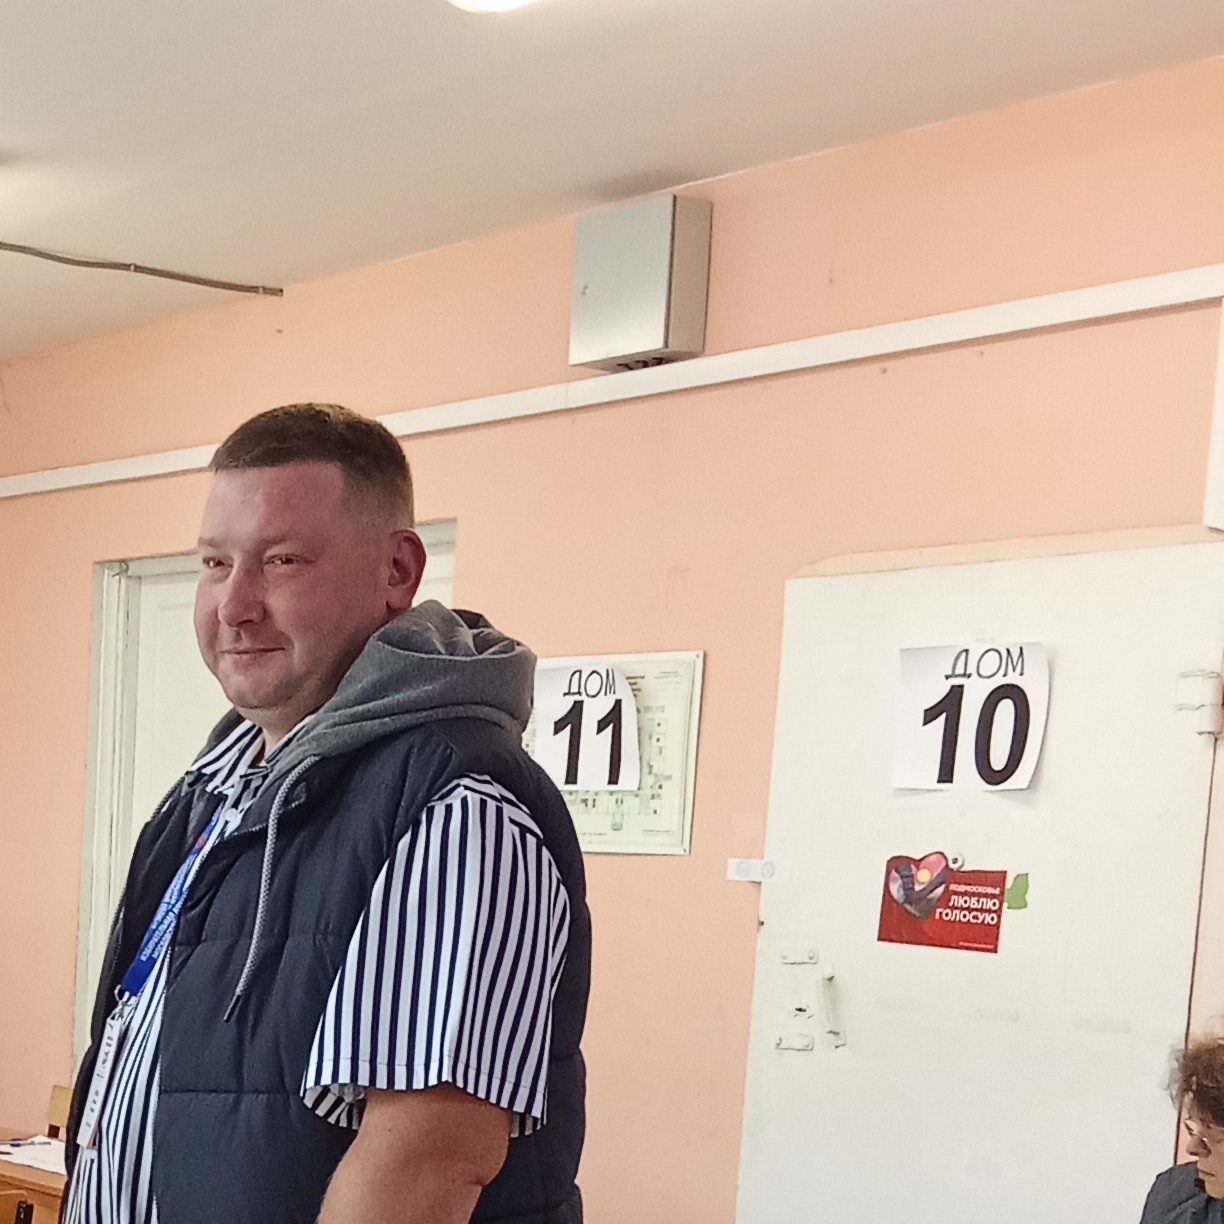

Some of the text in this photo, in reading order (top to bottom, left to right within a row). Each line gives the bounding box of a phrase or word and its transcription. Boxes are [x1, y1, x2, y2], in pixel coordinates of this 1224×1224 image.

[944, 646, 1025, 680] ДОМ
[562, 668, 616, 699] ДОМ
[553, 698, 623, 785] 11
[922, 683, 1031, 786] 10
[935, 908, 998, 925] ГОЛОСУЮ
[948, 895, 1000, 910] ЛЮБЛЮ
